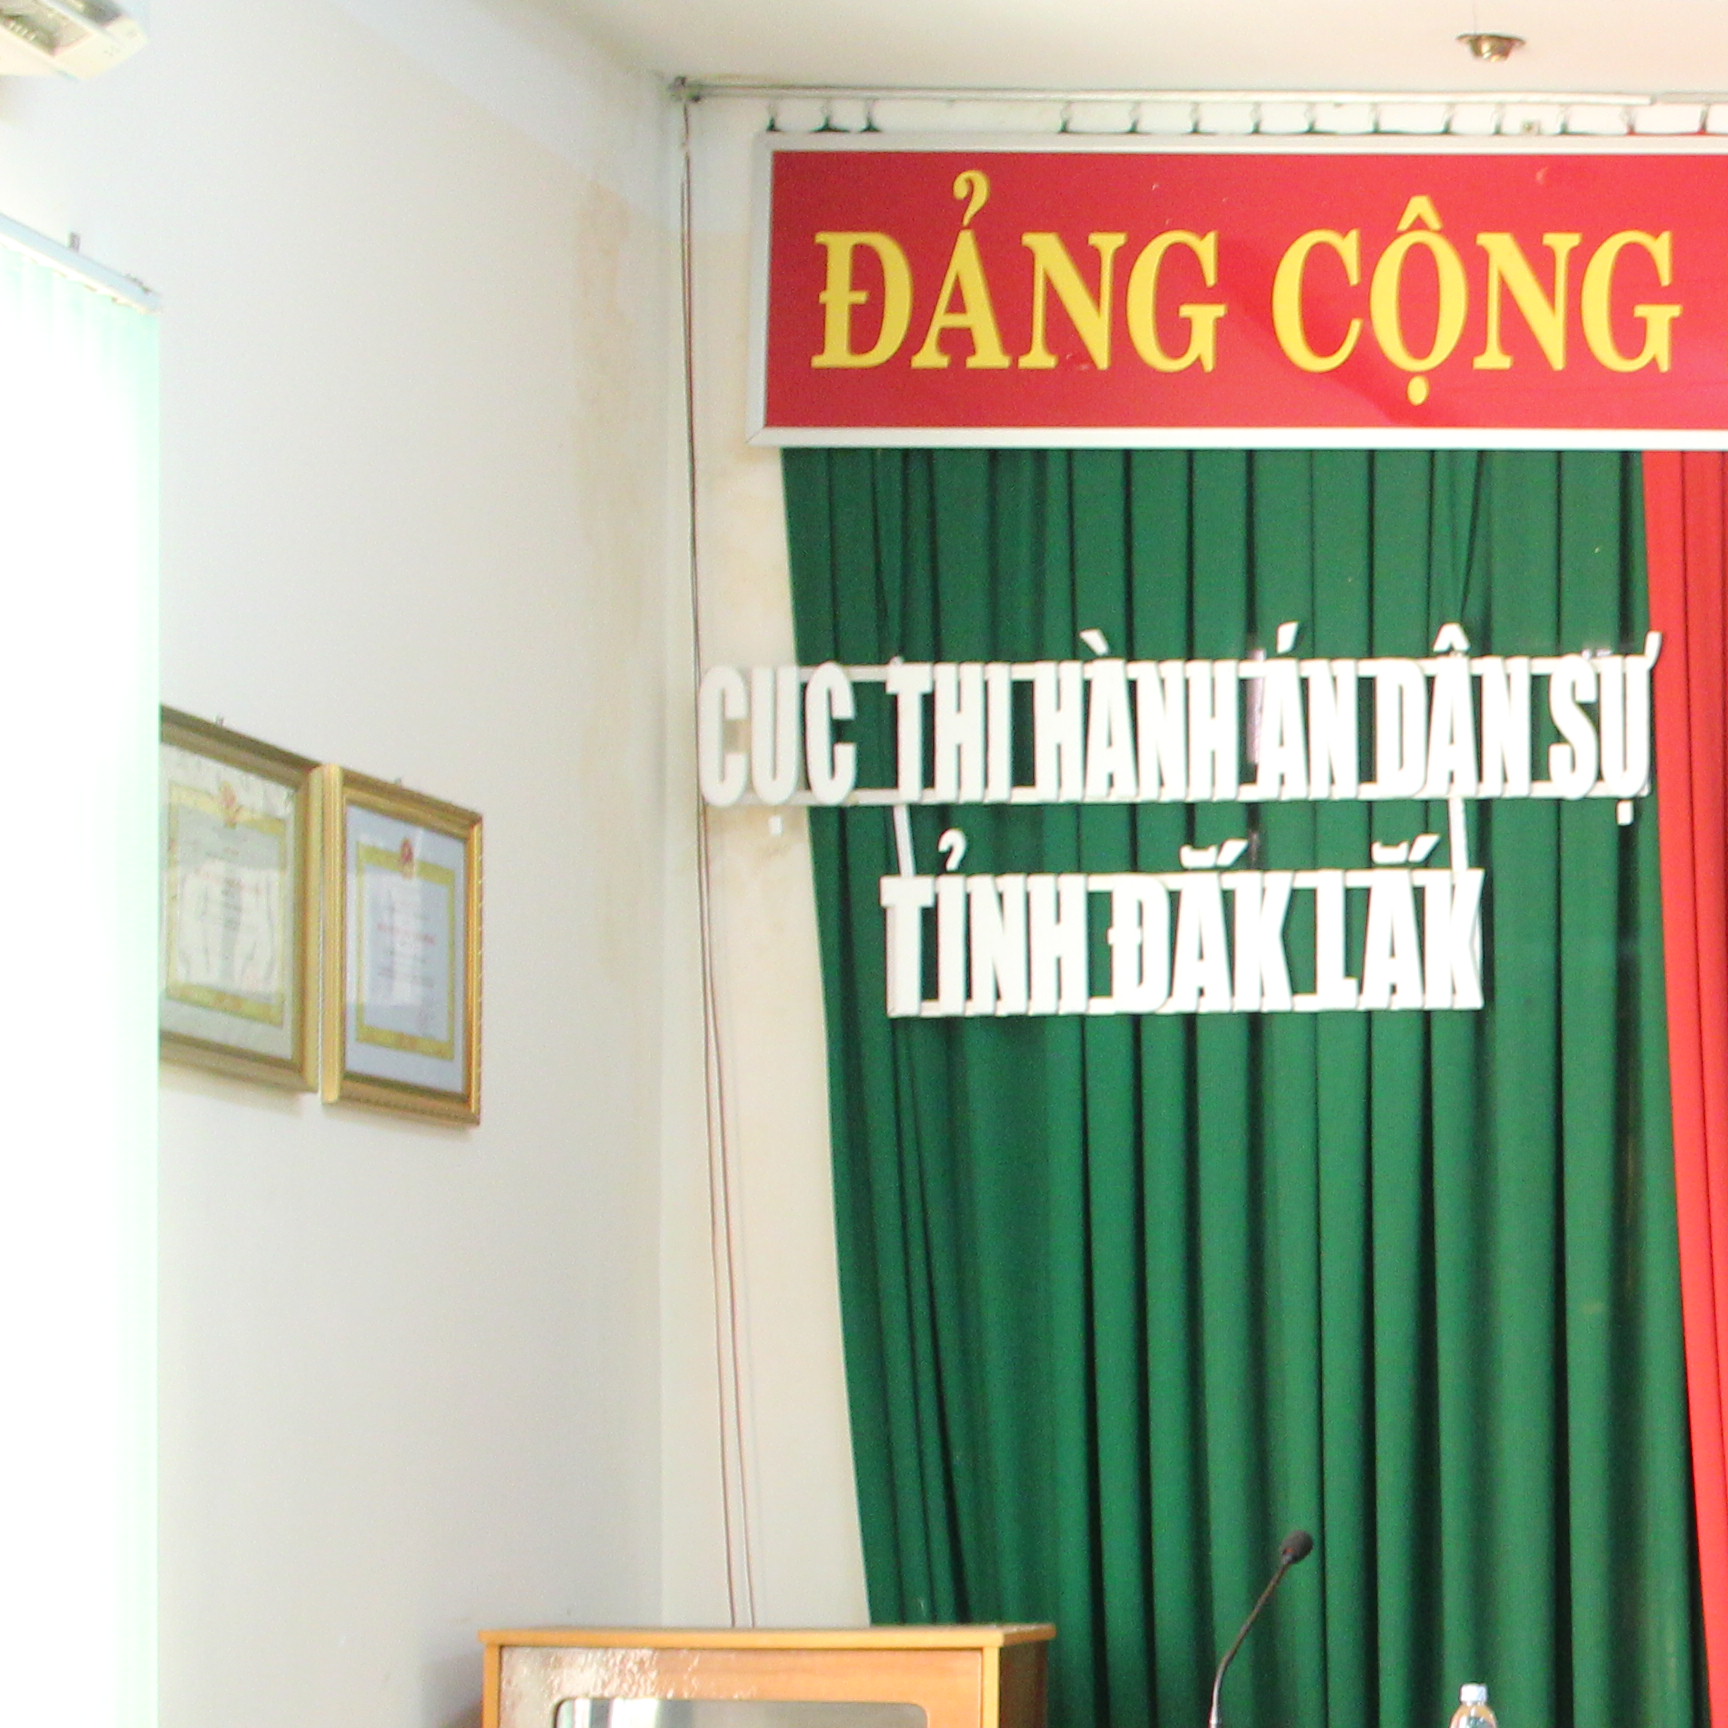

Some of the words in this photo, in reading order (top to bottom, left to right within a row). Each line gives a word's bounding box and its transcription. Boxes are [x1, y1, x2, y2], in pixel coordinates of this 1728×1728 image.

[811, 169, 1229, 374] ĐẢNG
[1271, 194, 1684, 407] CỘNG
[700, 662, 857, 836] CỤC
[886, 660, 1012, 803] THI
[1033, 628, 1240, 801] HÀNH
[1255, 622, 1362, 799] ÁN
[1376, 622, 1538, 799] DÂN
[1548, 630, 1662, 826] SỰ
[880, 828, 1091, 1018] TỈNH
[1107, 837, 1296, 1014] ĐẮK
[1313, 832, 1486, 1011] LẮK
